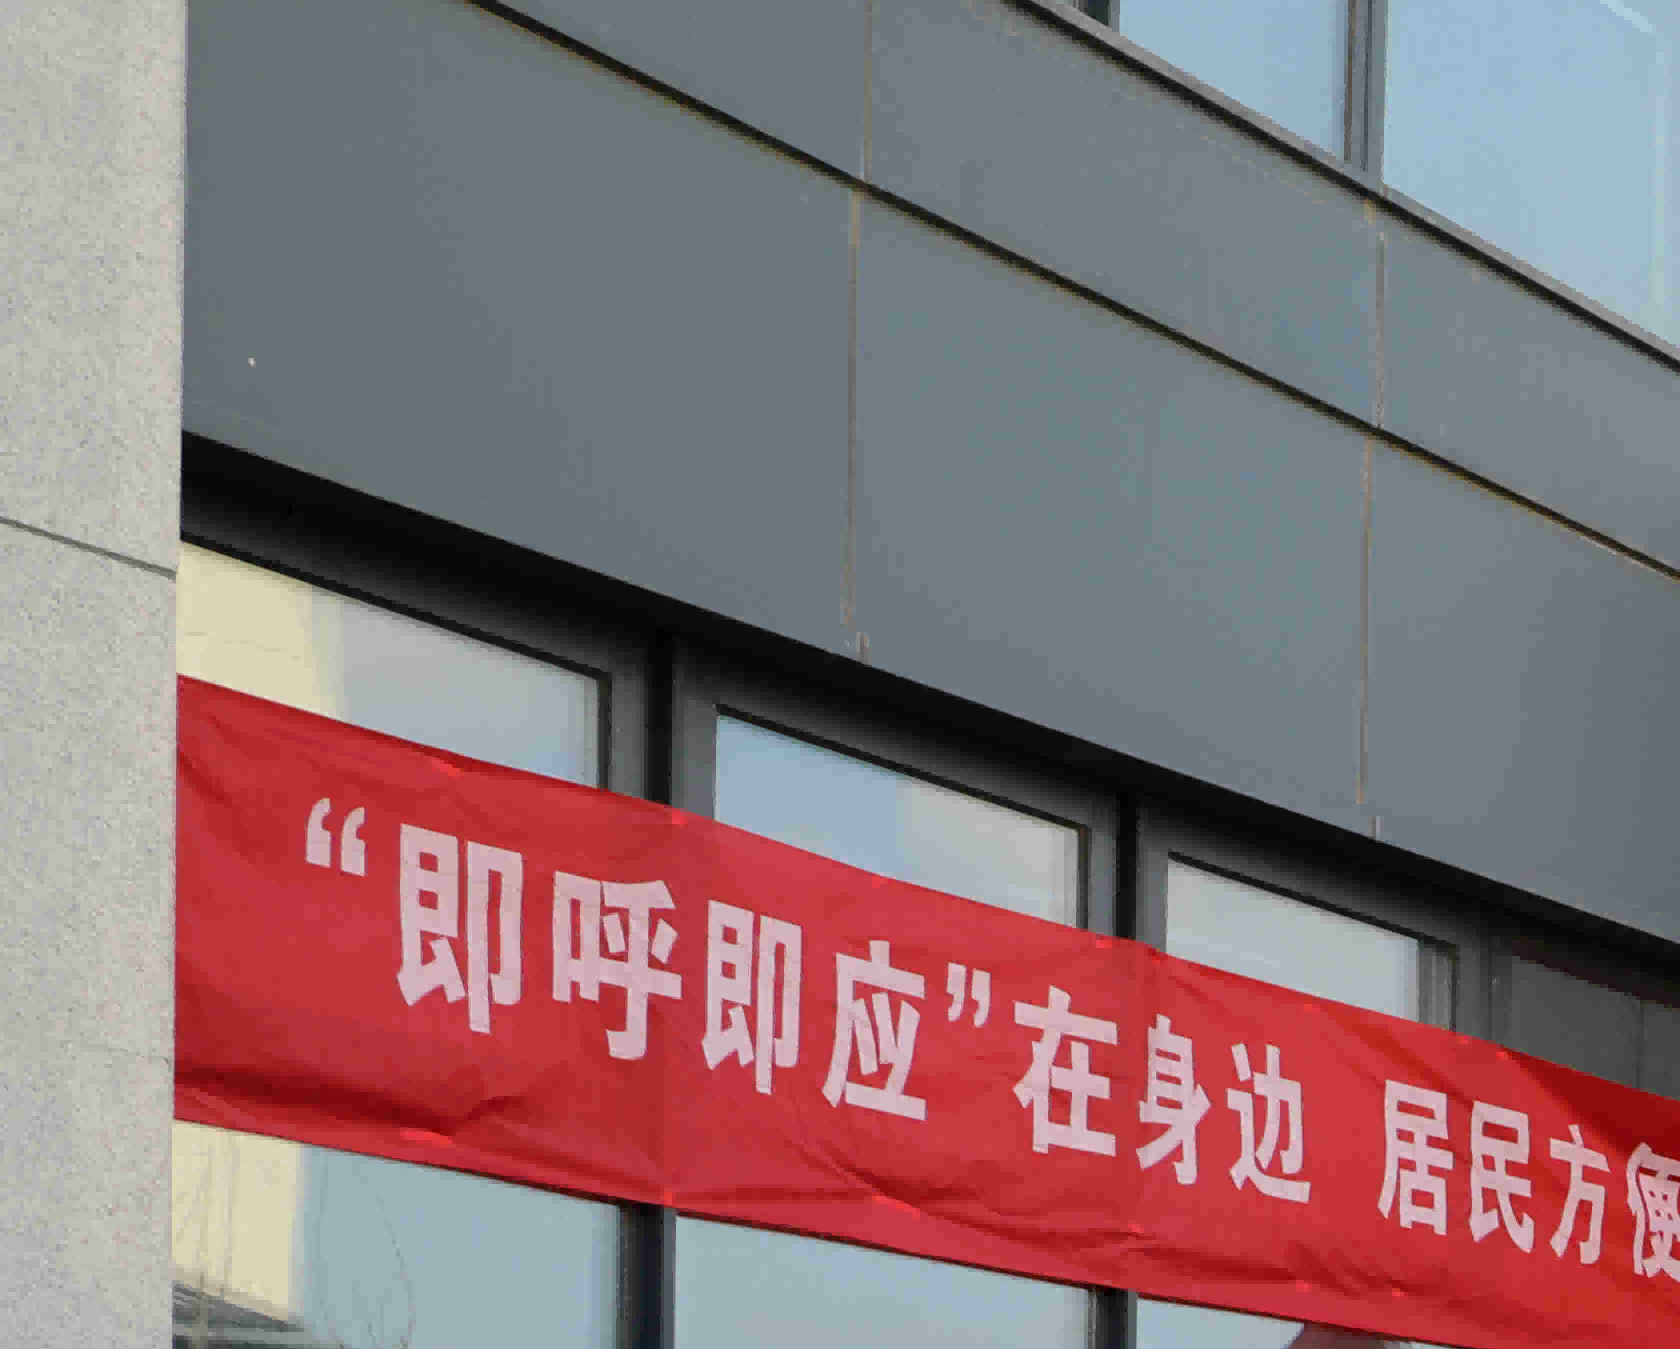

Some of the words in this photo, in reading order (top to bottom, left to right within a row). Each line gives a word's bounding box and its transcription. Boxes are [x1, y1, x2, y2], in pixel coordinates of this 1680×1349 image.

[305, 797, 1310, 1204] “即呼即应”在身边
